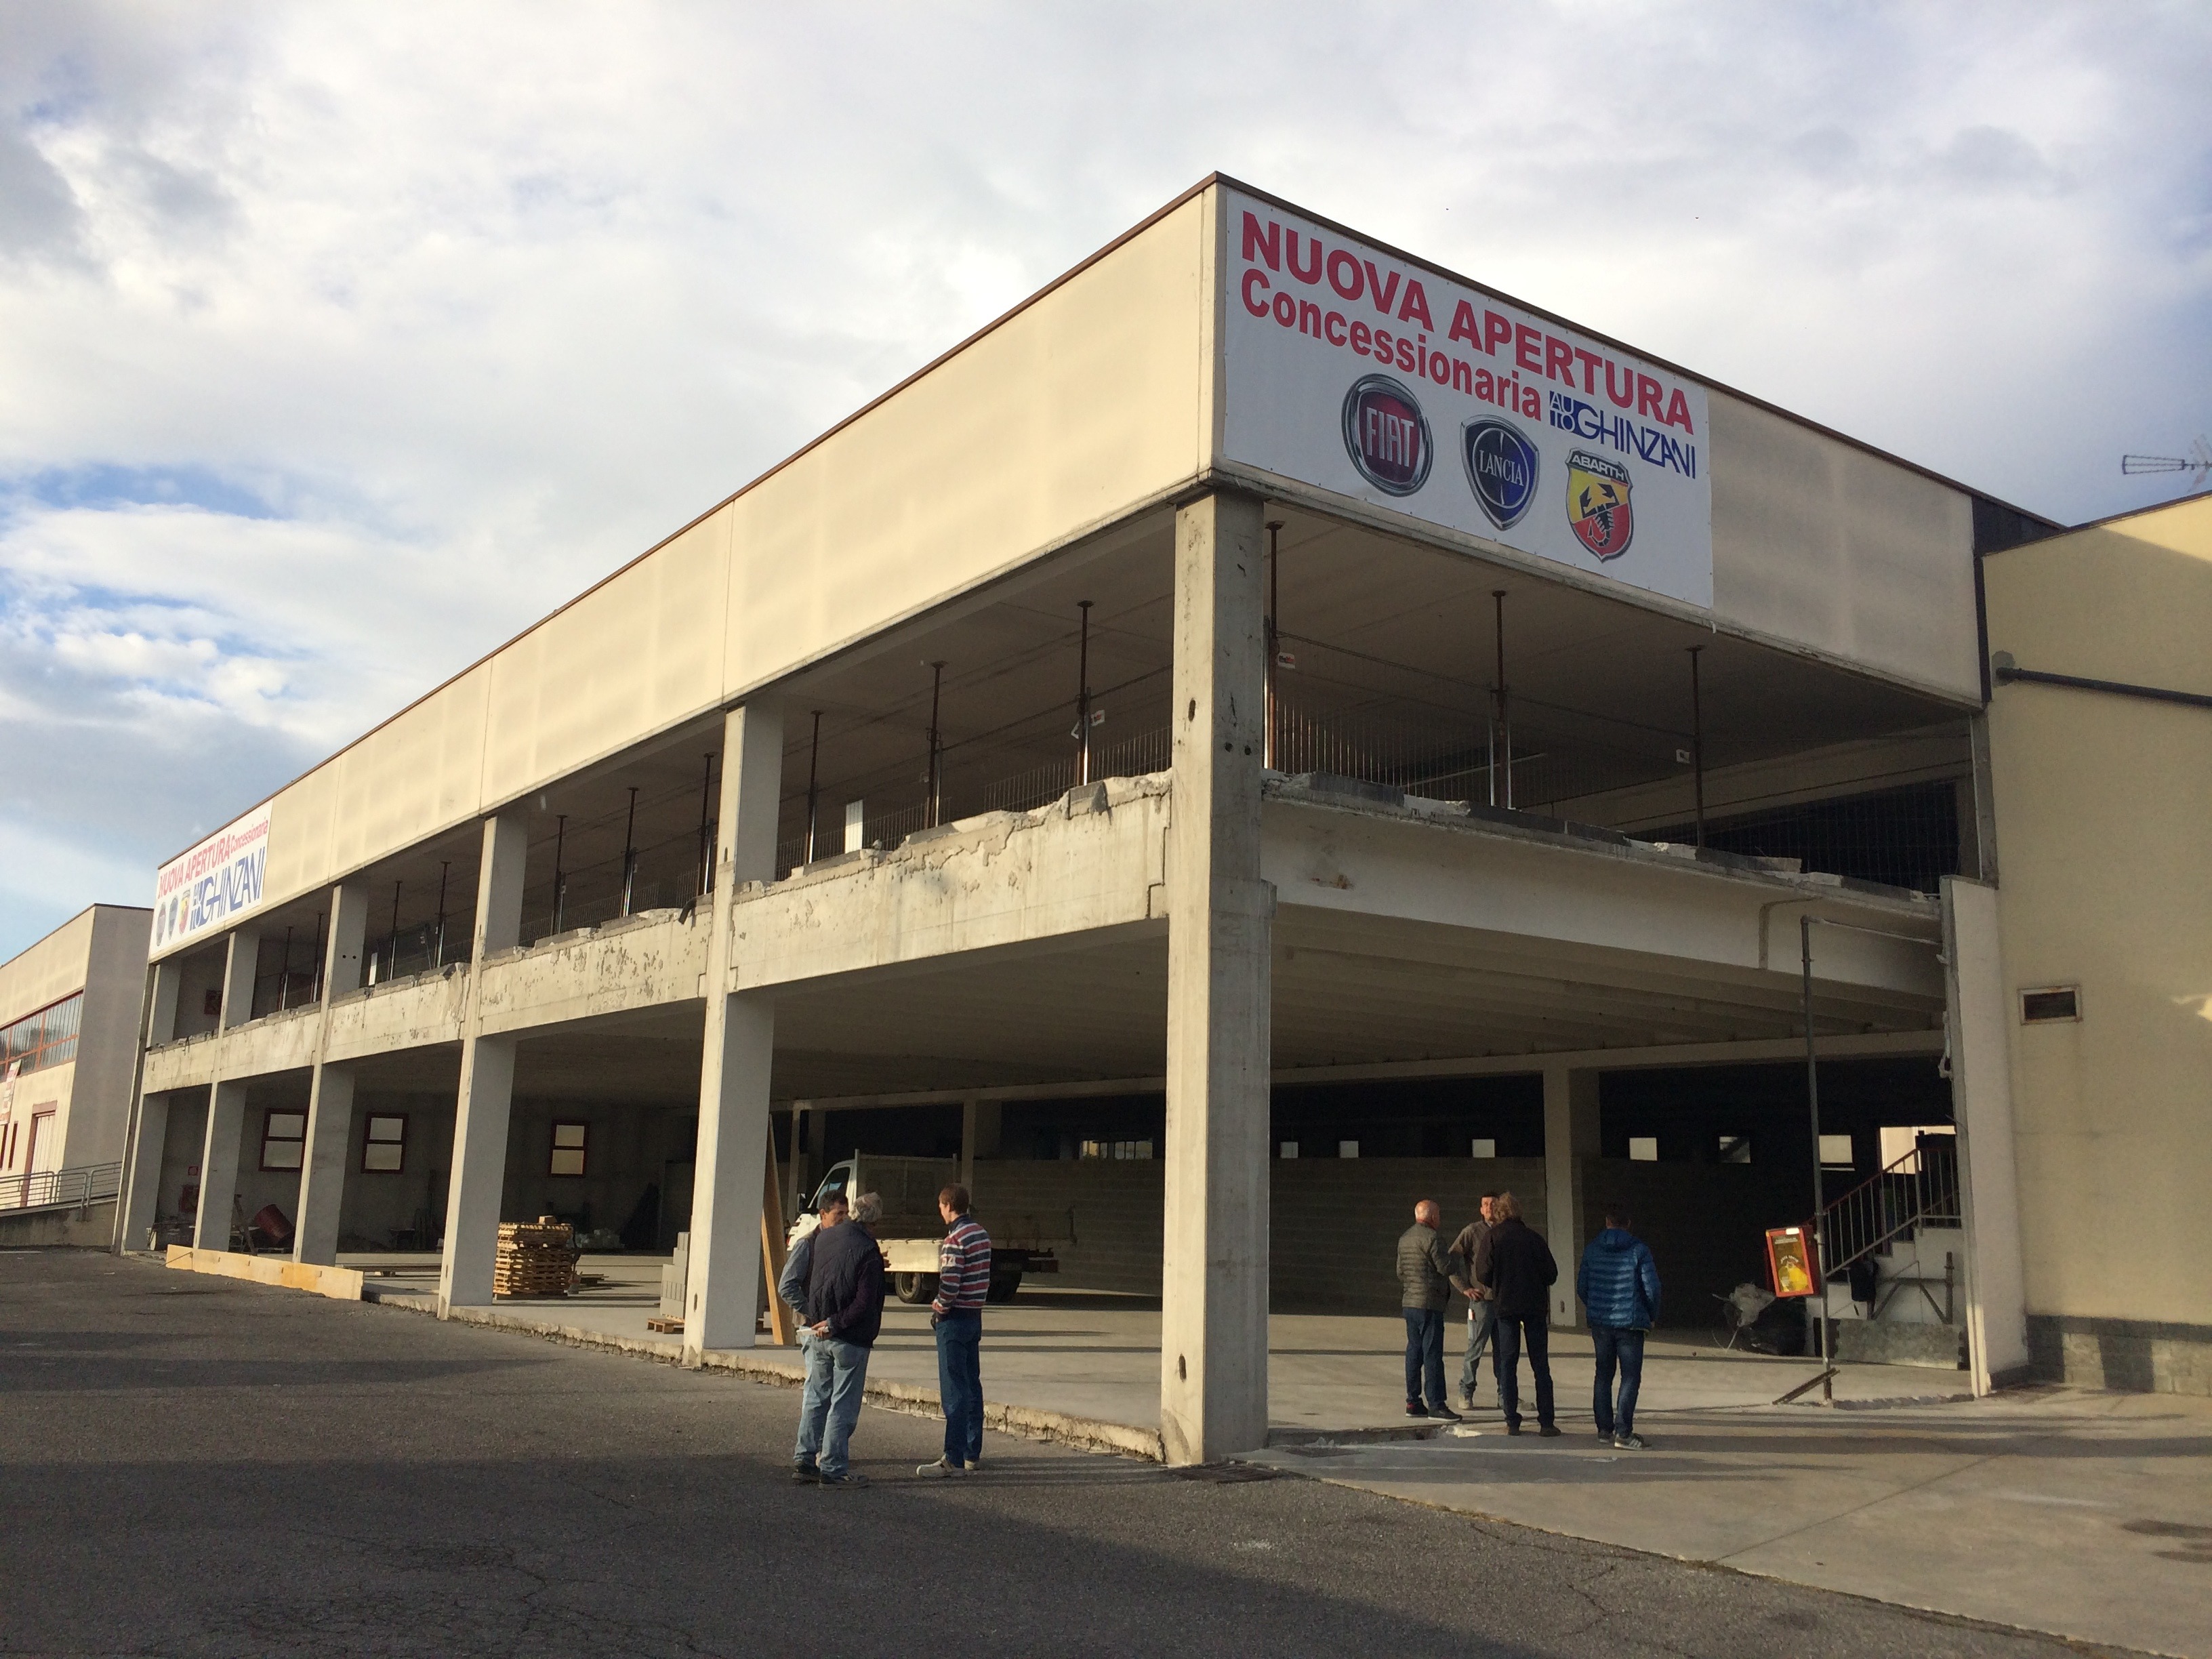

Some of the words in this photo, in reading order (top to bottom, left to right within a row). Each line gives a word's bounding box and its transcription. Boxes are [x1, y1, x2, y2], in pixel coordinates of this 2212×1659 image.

[1242, 211, 1434, 333] NUOVA
[1448, 300, 1694, 435] APERTURA
[1242, 268, 1541, 422] Concessionaria
[1366, 407, 1414, 468] FIAT
[1479, 449, 1524, 487] LANCIA
[1572, 454, 1626, 480] ABARTH
[158, 863, 184, 899] NUOVA
[184, 834, 231, 883] APERTURA
